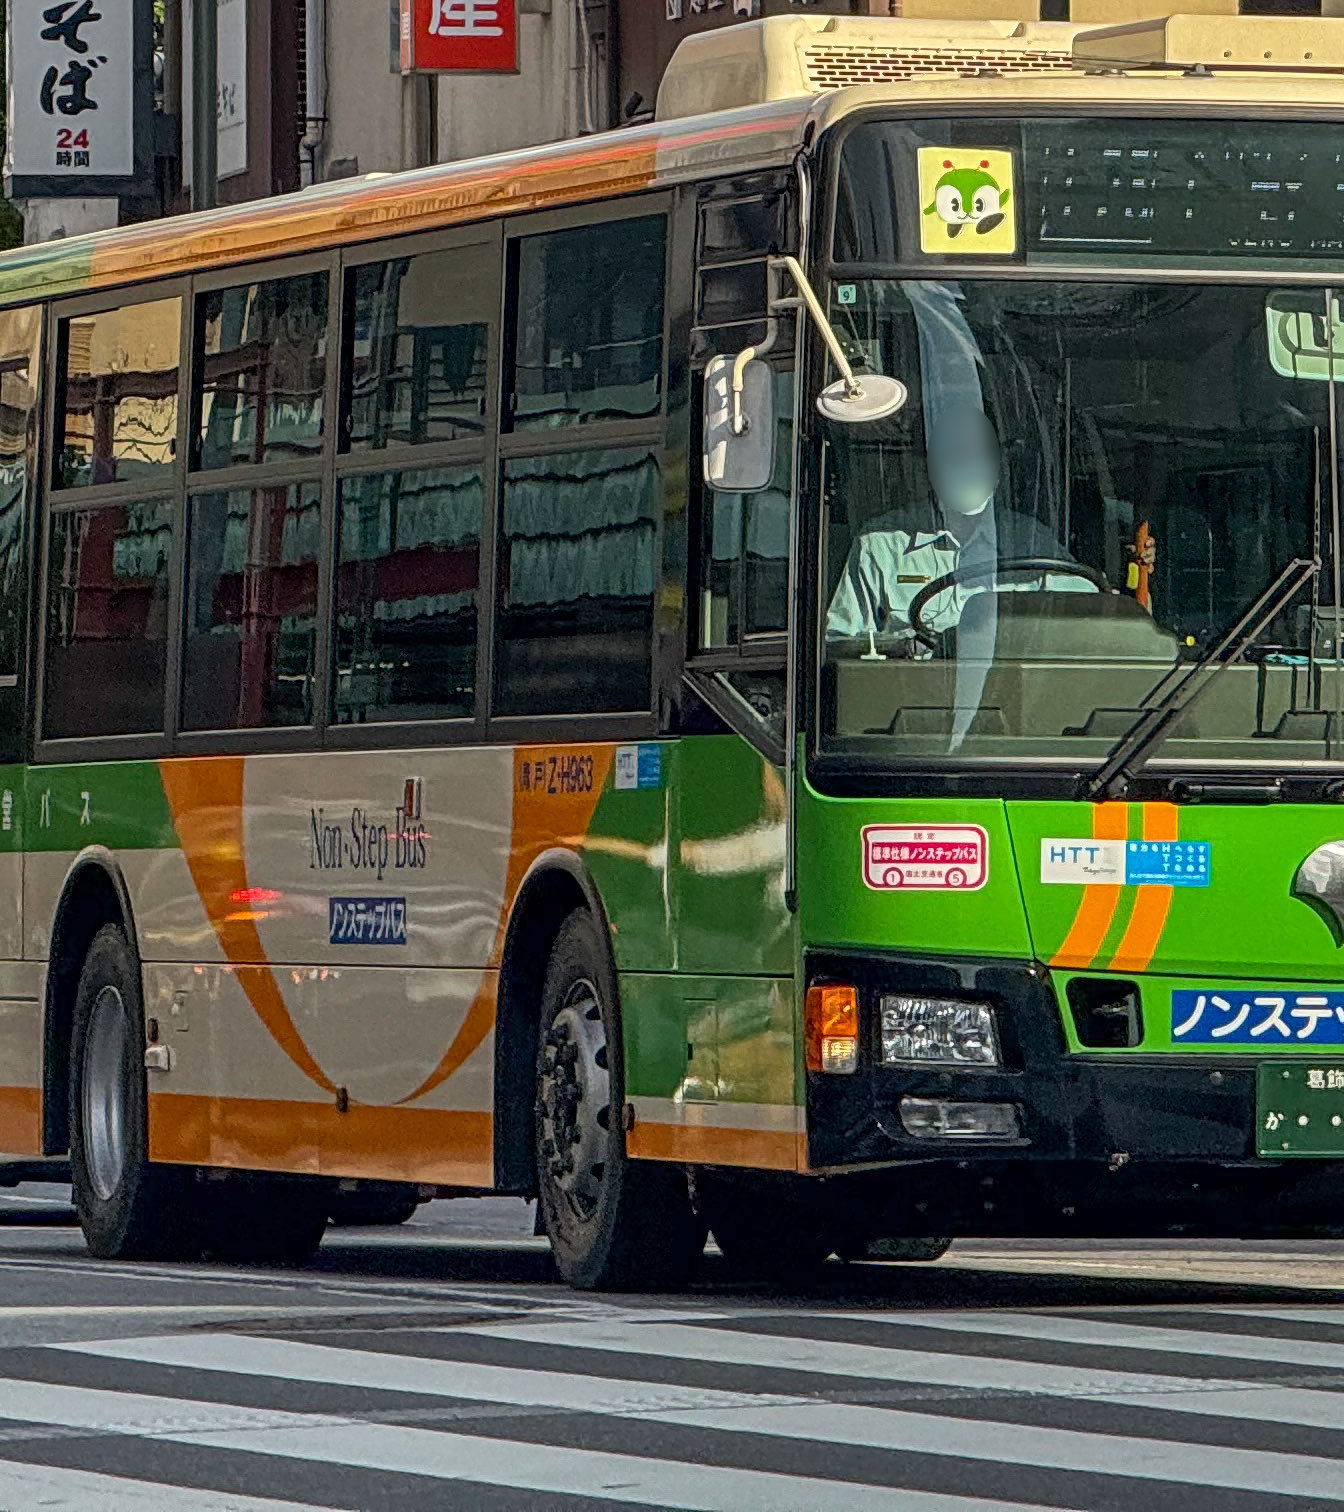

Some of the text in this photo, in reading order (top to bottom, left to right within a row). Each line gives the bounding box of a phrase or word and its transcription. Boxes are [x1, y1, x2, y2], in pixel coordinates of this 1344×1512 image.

[56, 128, 90, 149] 24
[56, 151, 90, 168] 時間
[395, 807, 426, 868] Bus
[1051, 846, 1100, 864] HTT
[330, 901, 405, 939] ノンステップバス
[1265, 1112, 1284, 1130] か
